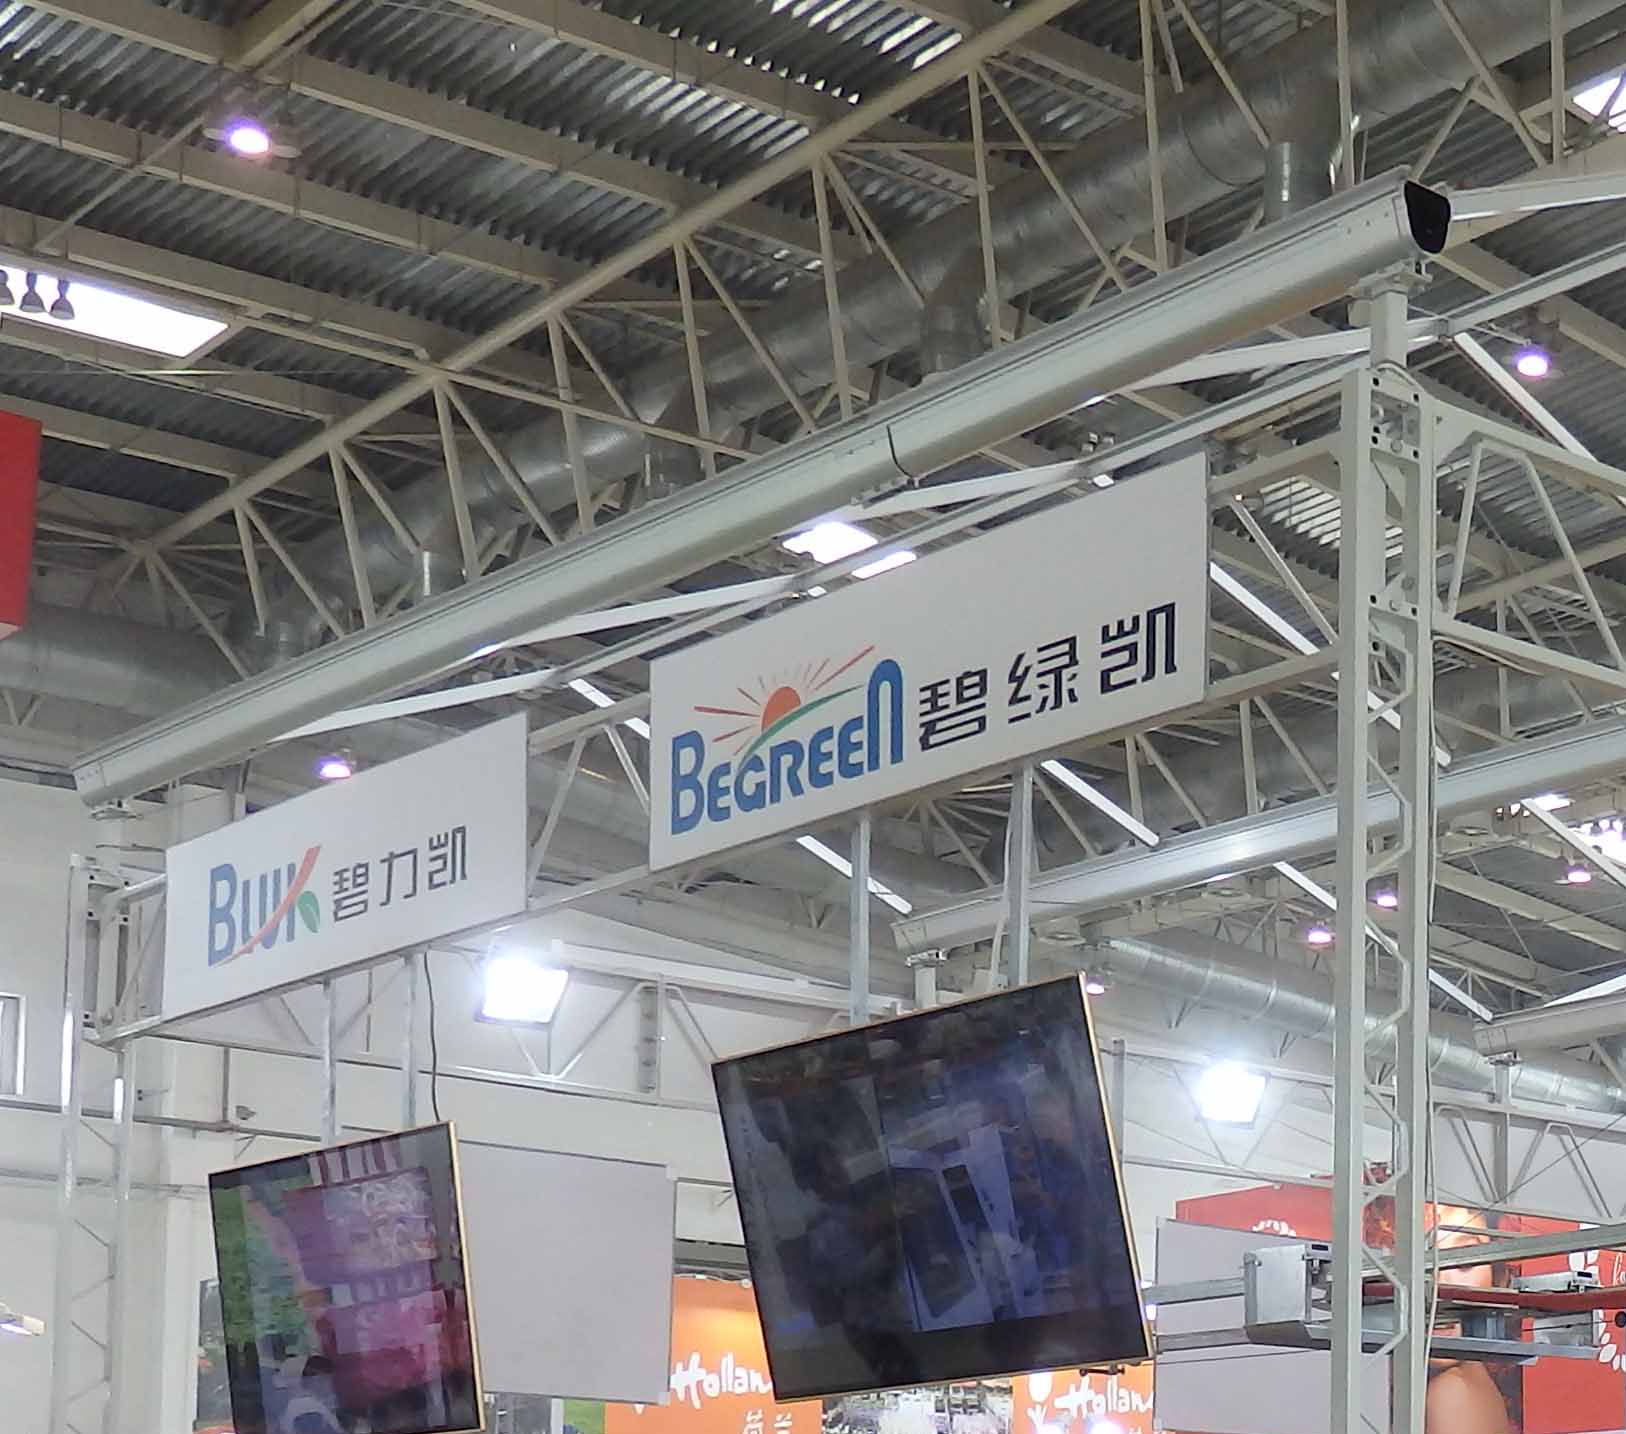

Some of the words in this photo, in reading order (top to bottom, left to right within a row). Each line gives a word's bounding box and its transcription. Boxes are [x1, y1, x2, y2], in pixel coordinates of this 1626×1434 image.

[918, 602, 1178, 754] 碧绿凯
[331, 824, 467, 923] 碧力凯
[671, 1352, 774, 1408] Hollan
[1054, 1375, 1155, 1419] Hollan
